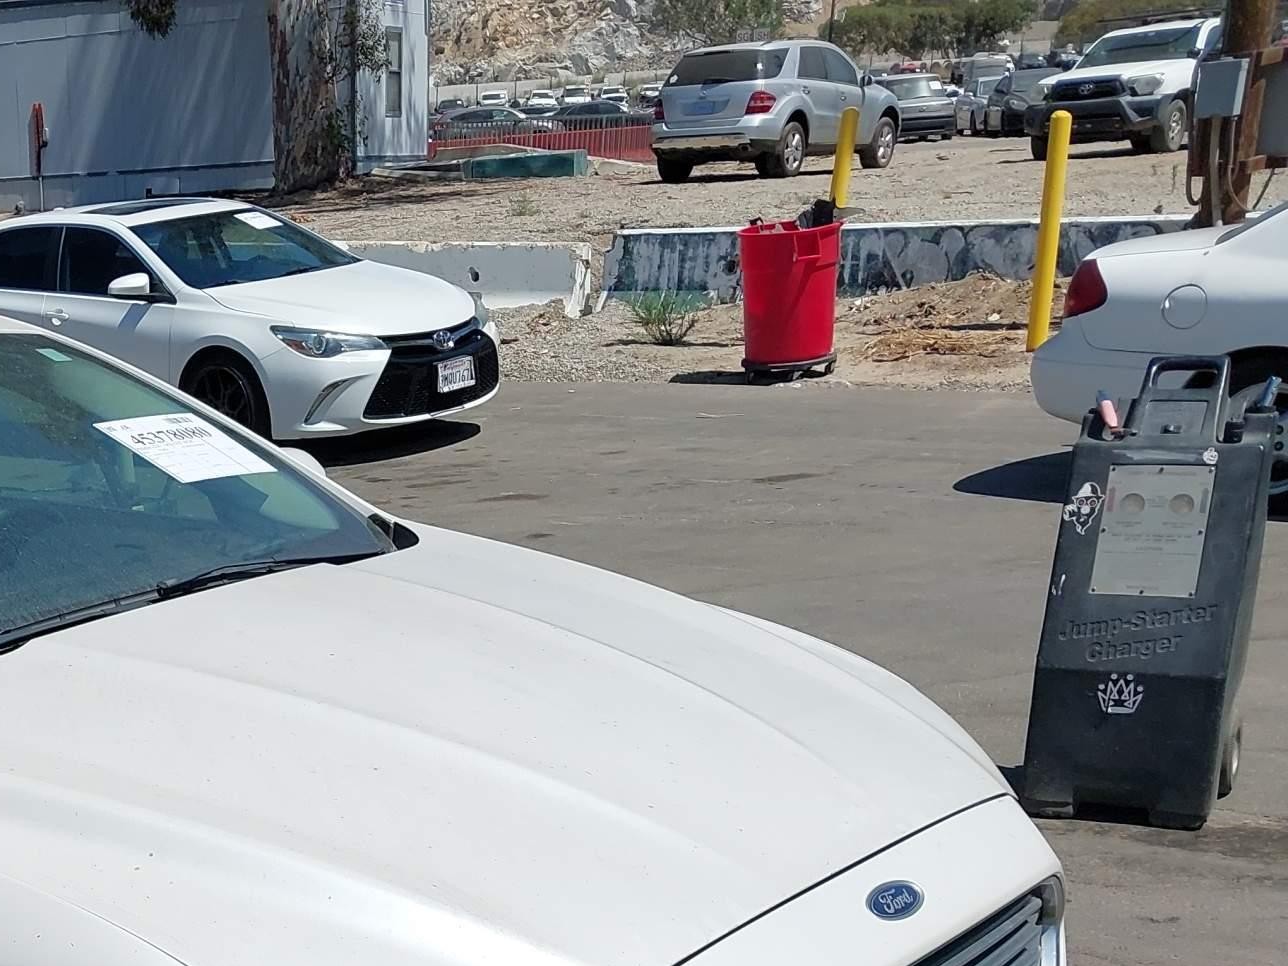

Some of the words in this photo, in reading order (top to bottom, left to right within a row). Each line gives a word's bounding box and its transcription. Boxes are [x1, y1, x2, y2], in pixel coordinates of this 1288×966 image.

[129, 425, 212, 446] 45378080
[1058, 603, 1219, 641] Jump-Starter
[1086, 634, 1184, 662] Charger
[878, 888, 914, 914] Ford
